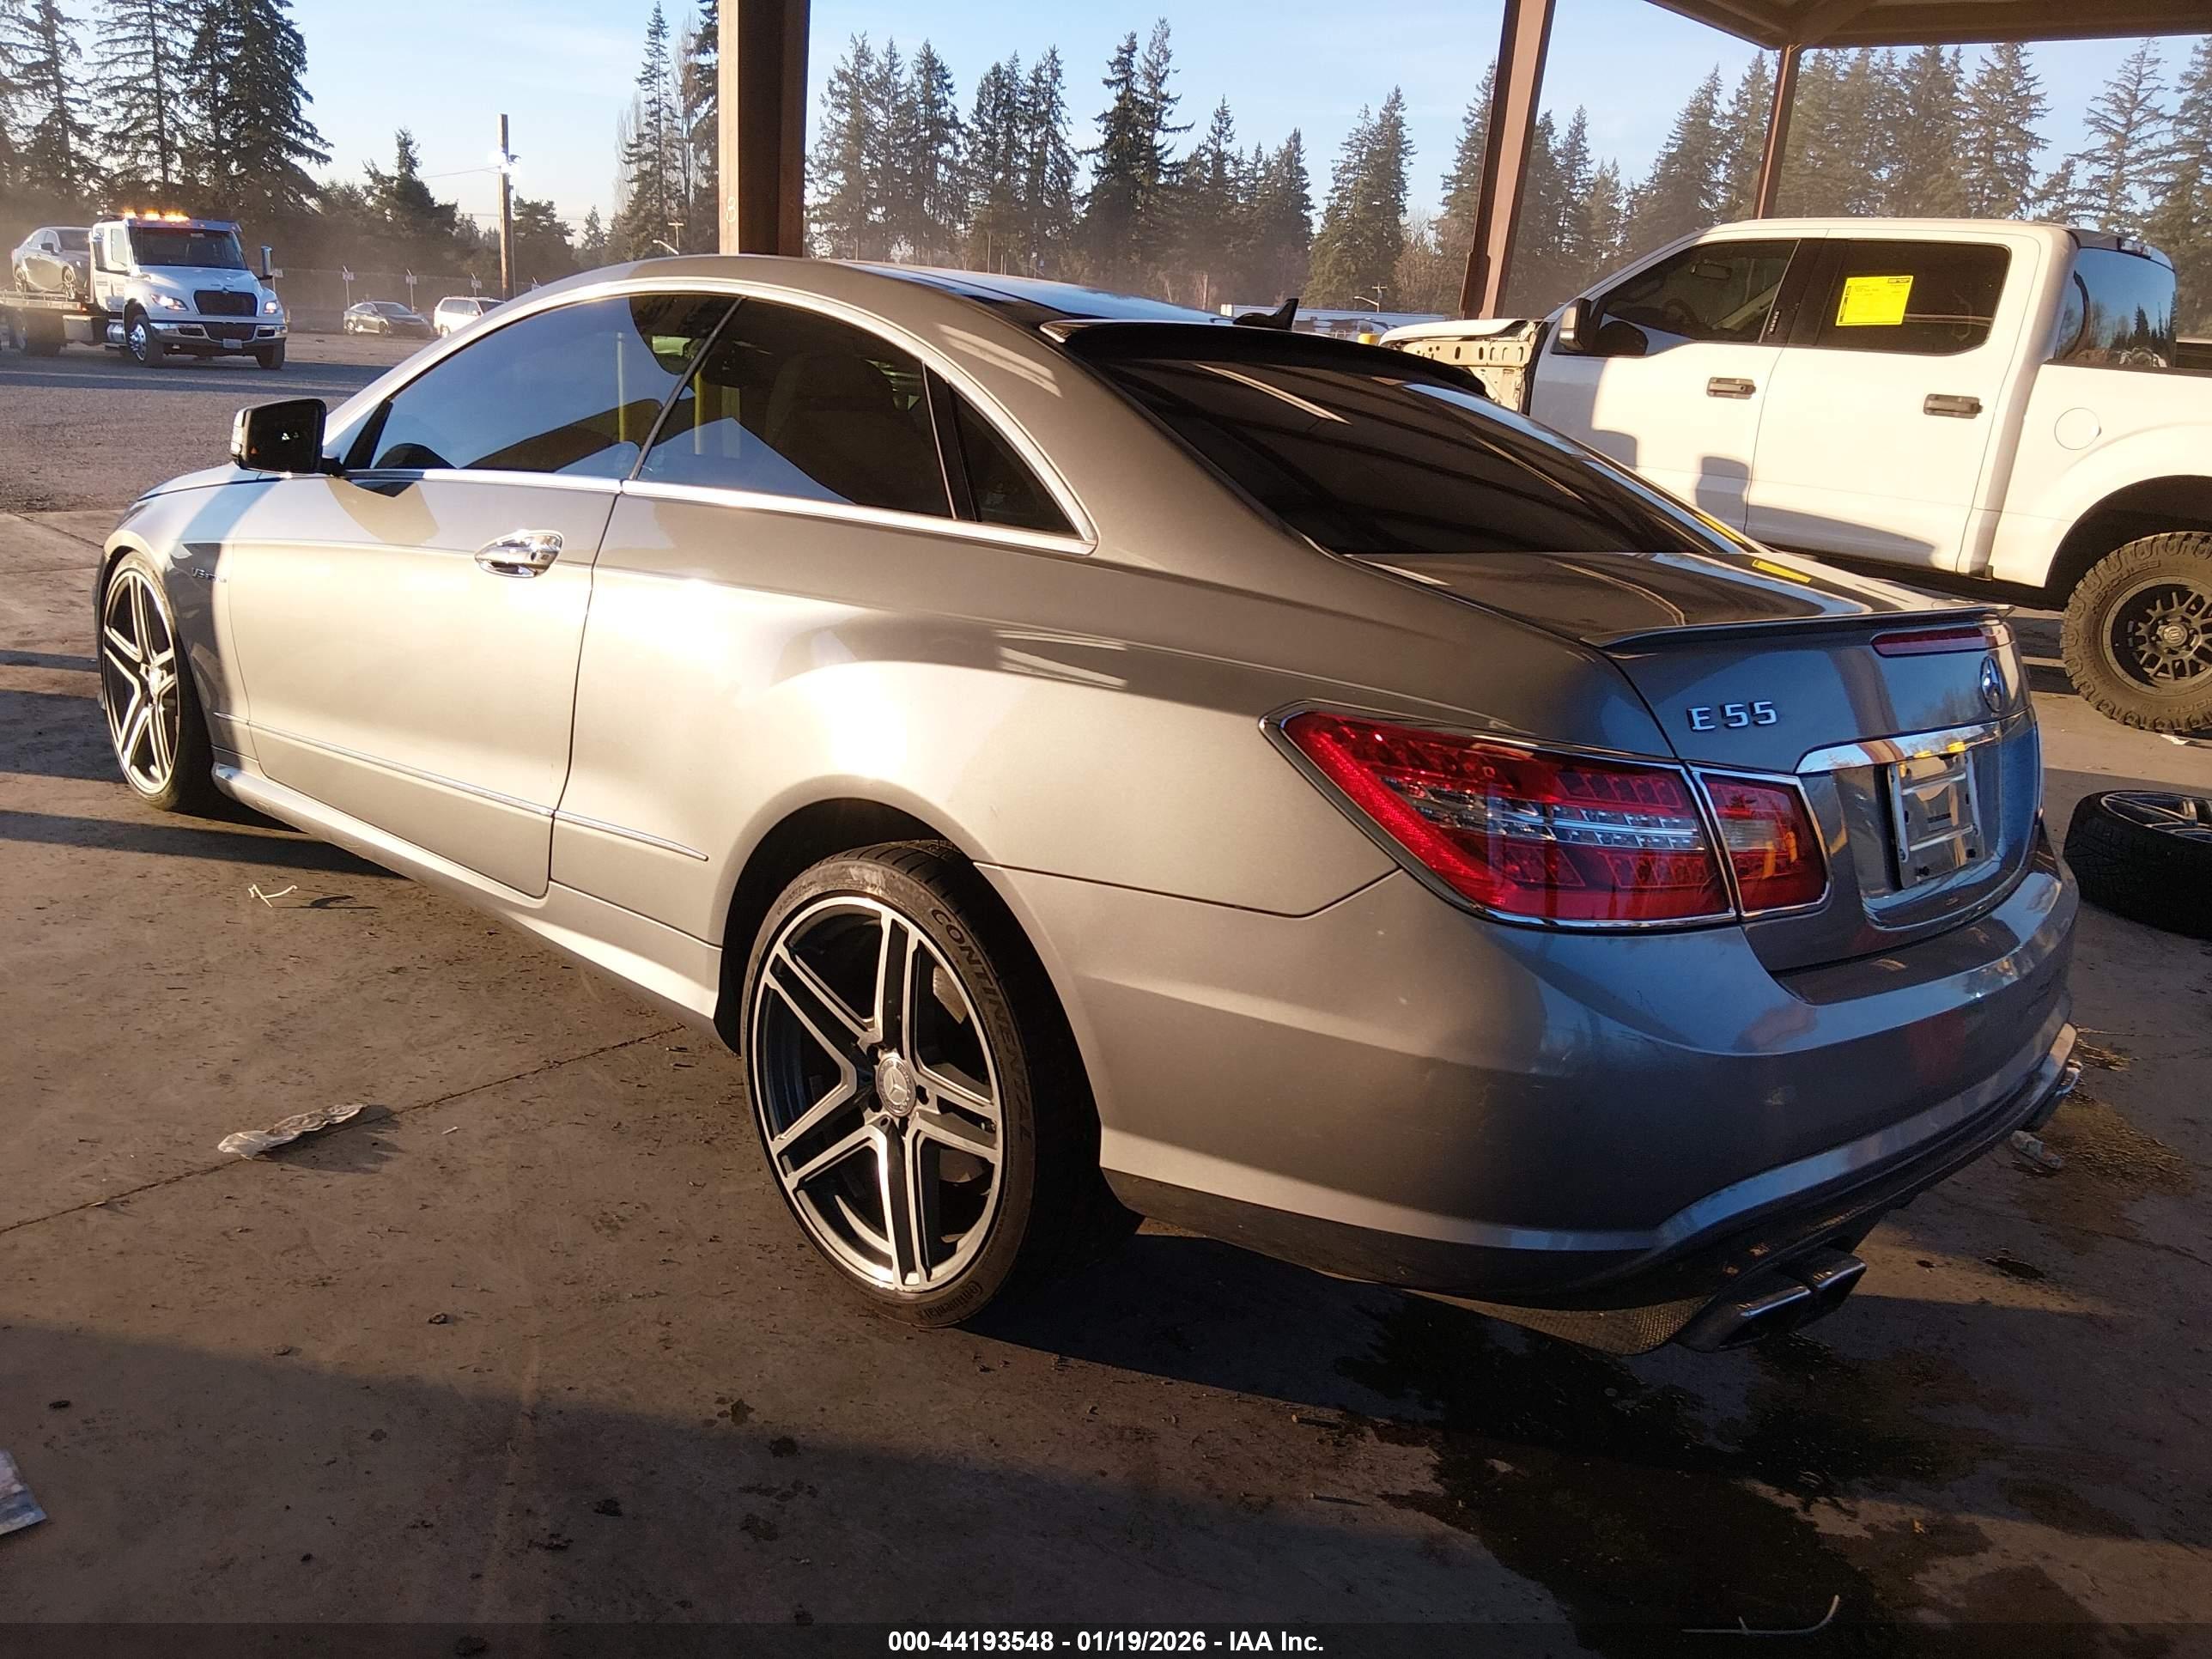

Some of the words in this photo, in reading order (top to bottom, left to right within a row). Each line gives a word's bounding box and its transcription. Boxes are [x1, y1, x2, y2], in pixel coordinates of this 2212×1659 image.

[1686, 707, 1717, 731] E
[1720, 701, 1778, 728] 55
[930, 908, 1034, 1144] CONTINENTAL
